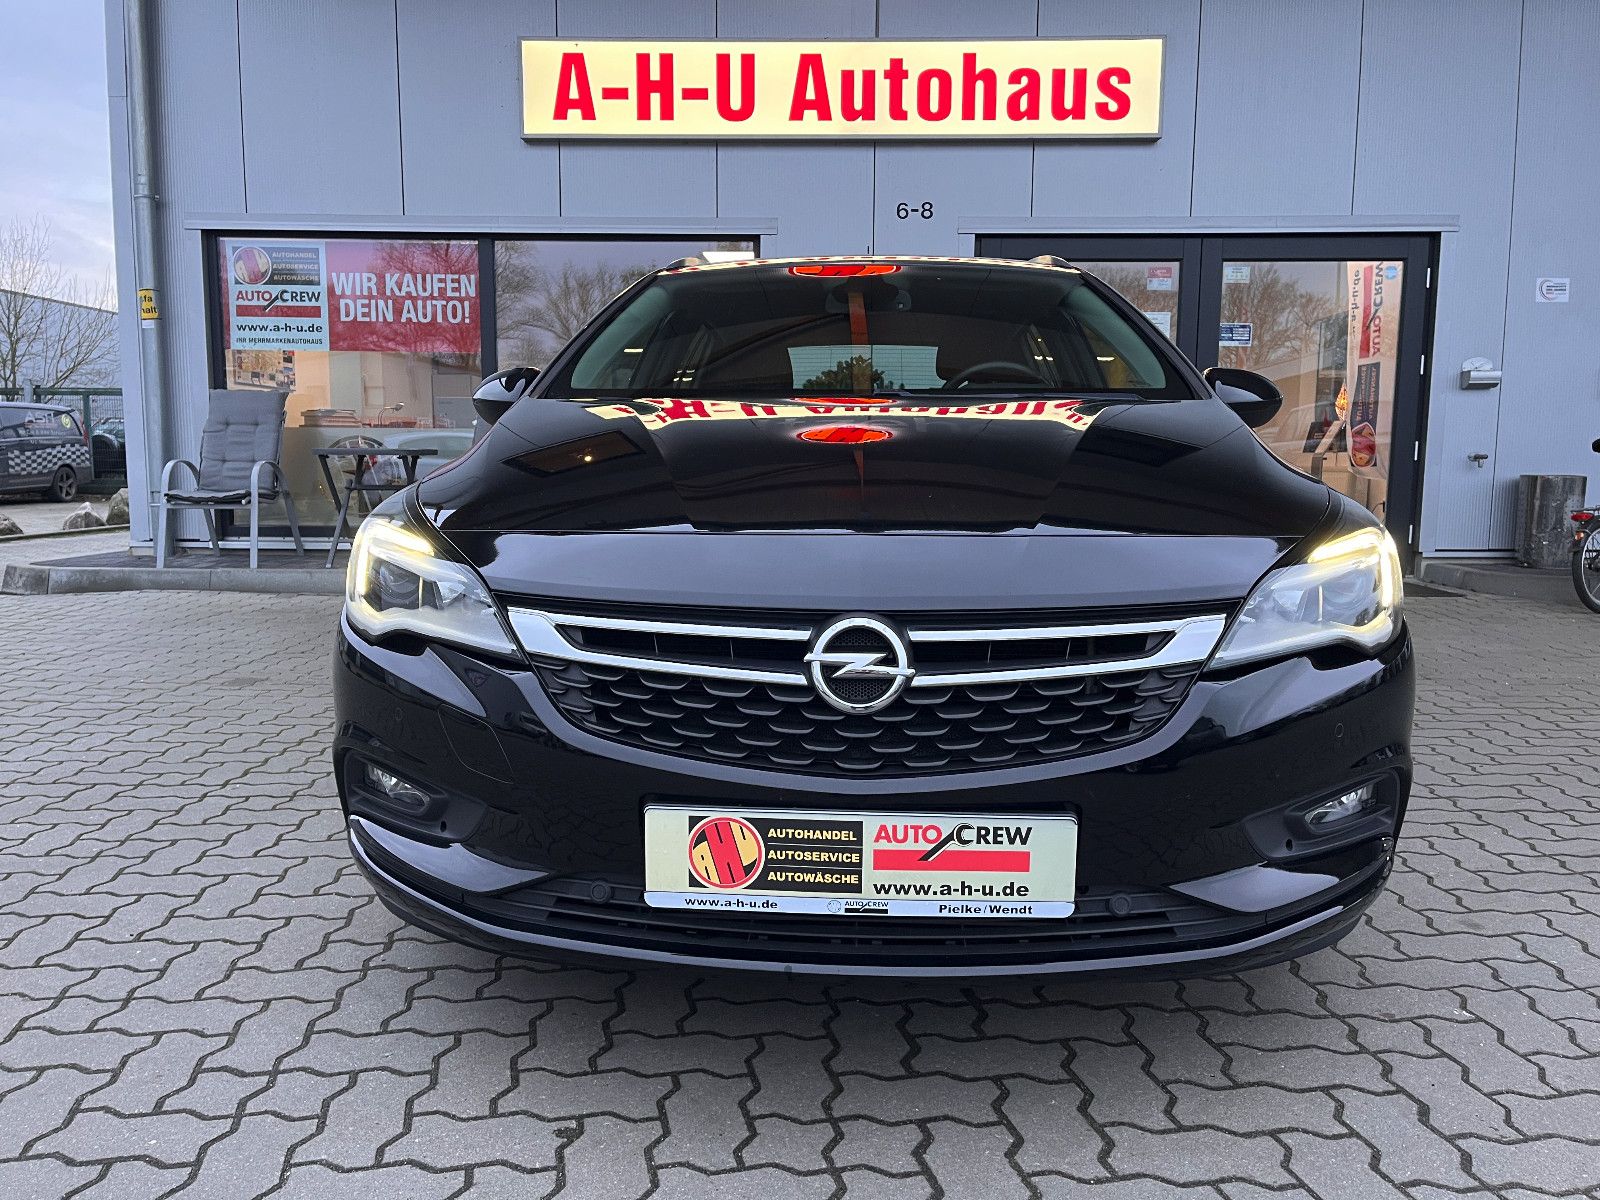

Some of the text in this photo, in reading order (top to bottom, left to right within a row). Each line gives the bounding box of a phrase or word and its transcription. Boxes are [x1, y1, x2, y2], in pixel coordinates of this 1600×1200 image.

[552, 53, 1132, 122] A-H-U Autohaus
[896, 201, 934, 220] 6-8
[331, 272, 476, 297] WIR KAUFEN
[340, 299, 470, 324] DEIN AUTO!
[237, 323, 323, 333] www.a-h-u.de
[248, 337, 323, 345] MEHRMARKENAUTOHAUS
[768, 828, 857, 841] AUTOHANDEL
[768, 850, 860, 863] AUTOSERVICE
[767, 871, 859, 884] AUTOWÄSCHE
[873, 881, 1030, 897] www.a-h-u.de
[684, 898, 778, 909] www.a-h-u.de
